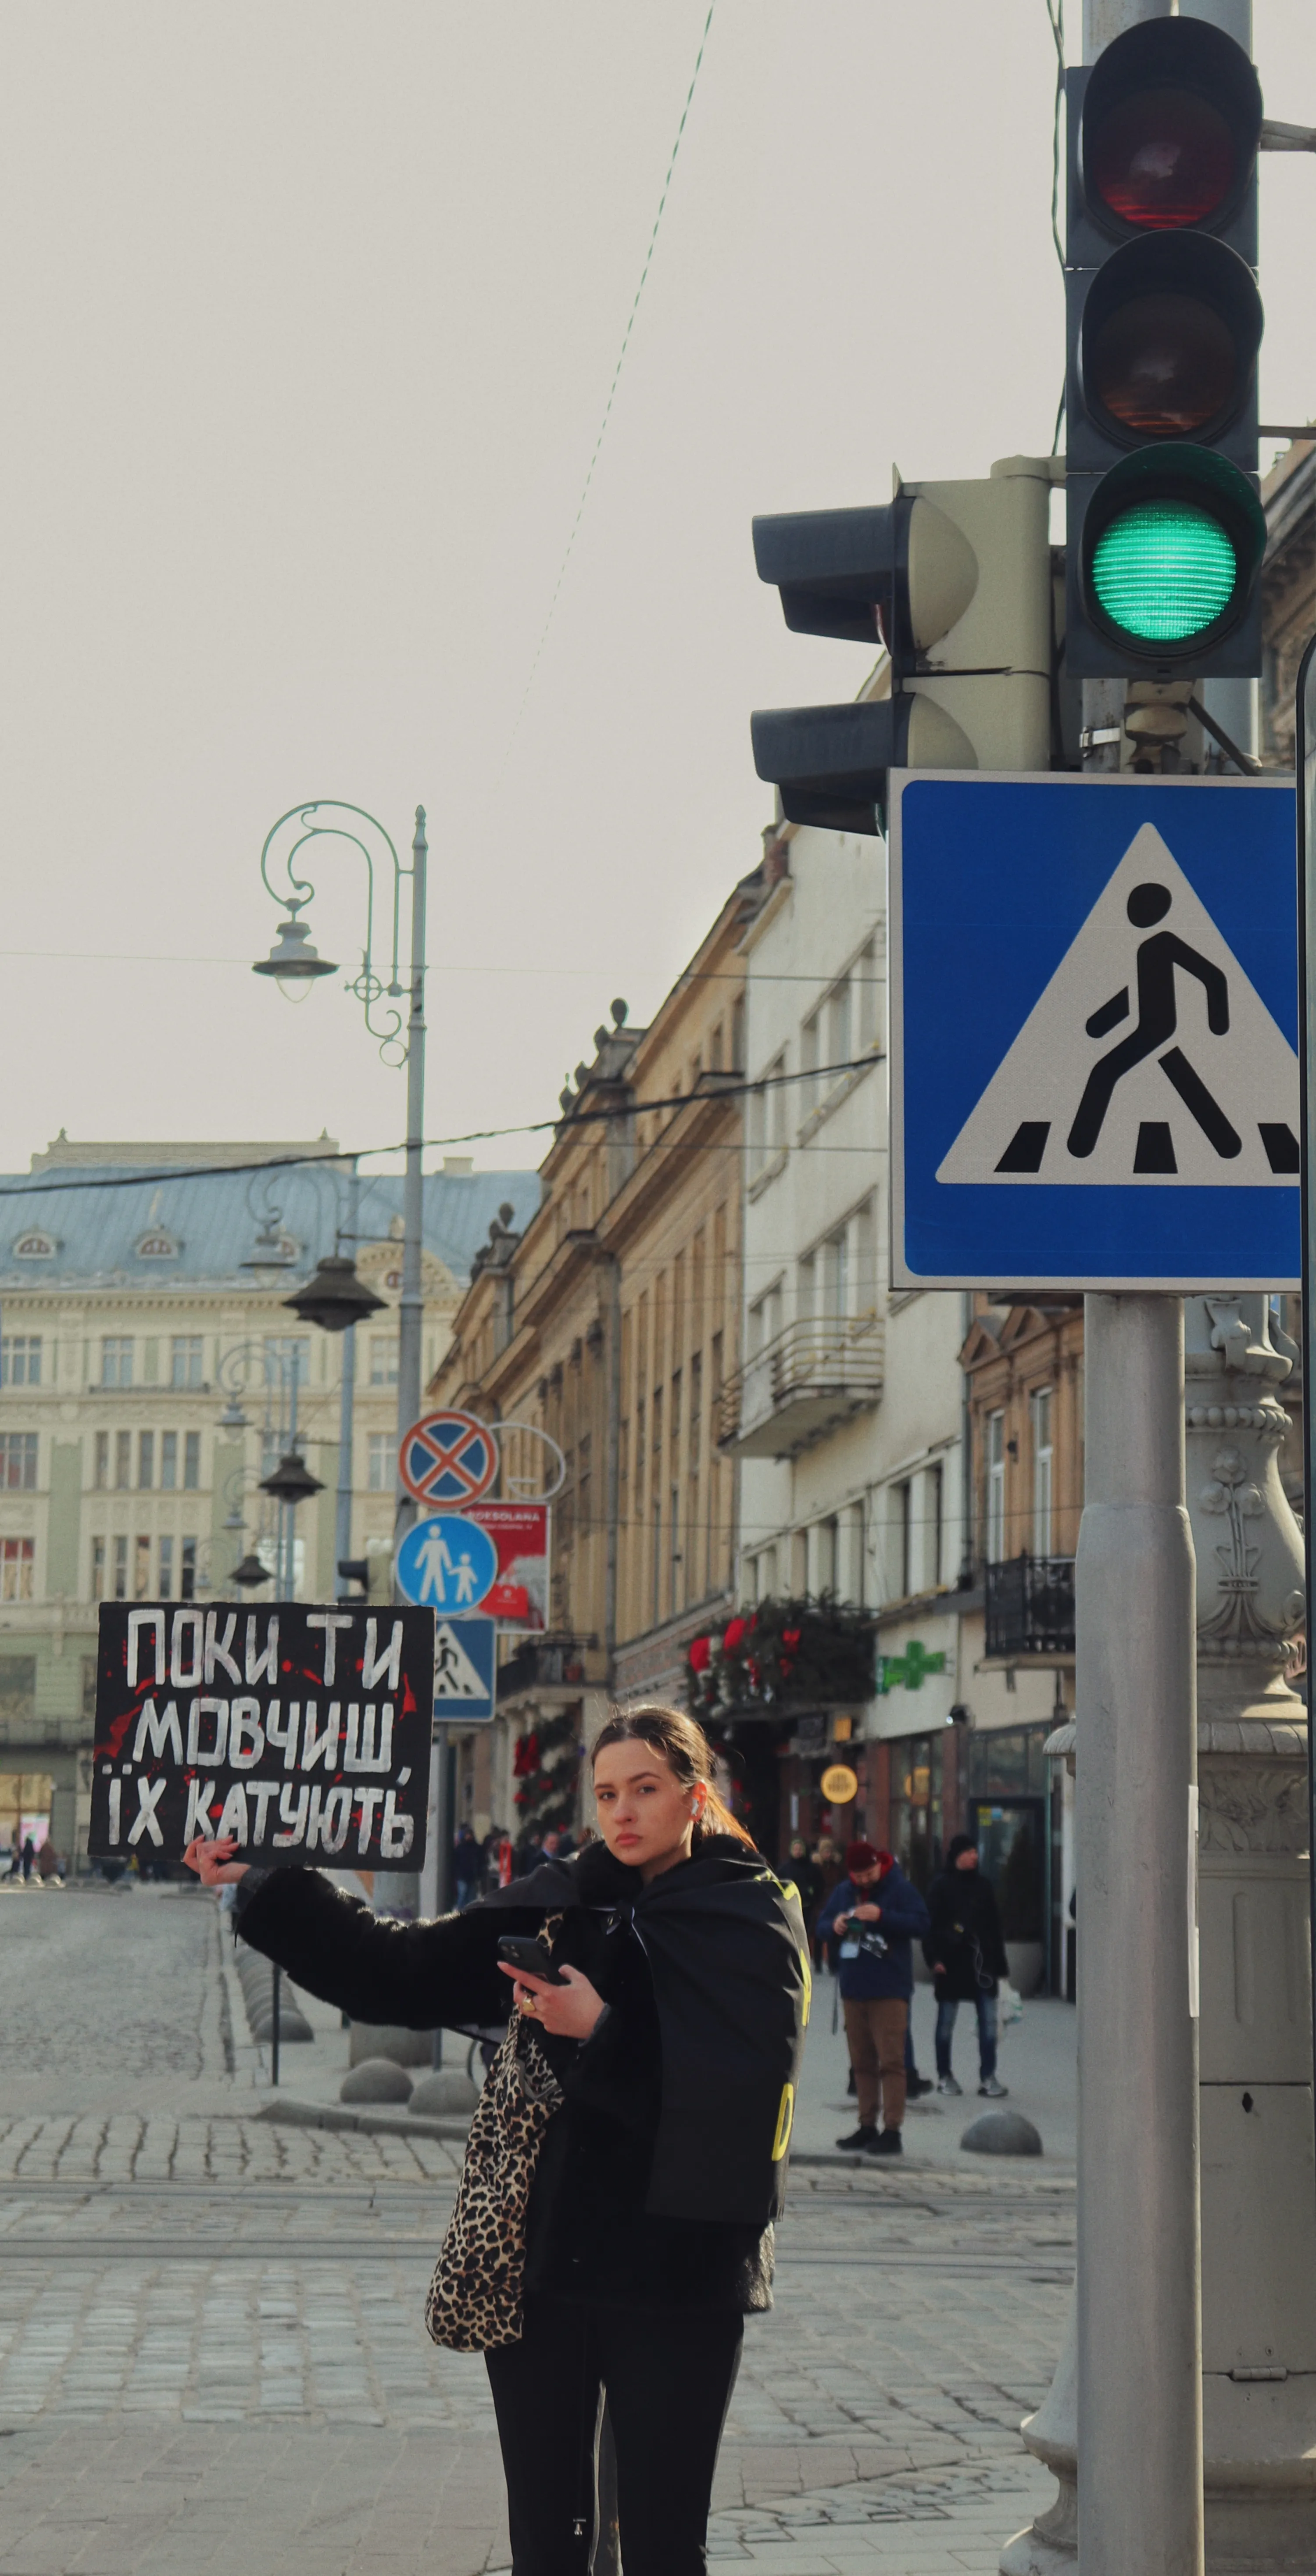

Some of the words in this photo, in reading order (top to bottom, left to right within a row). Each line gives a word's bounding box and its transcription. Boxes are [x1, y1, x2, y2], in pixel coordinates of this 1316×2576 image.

[127, 1609, 279, 1688] ПОКИ
[306, 1614, 404, 1690] ТИ
[133, 1697, 411, 1785] МОВЧИШ,
[102, 1764, 167, 1846] ЇХ
[184, 1779, 415, 1859] КАТУЮТЬ
